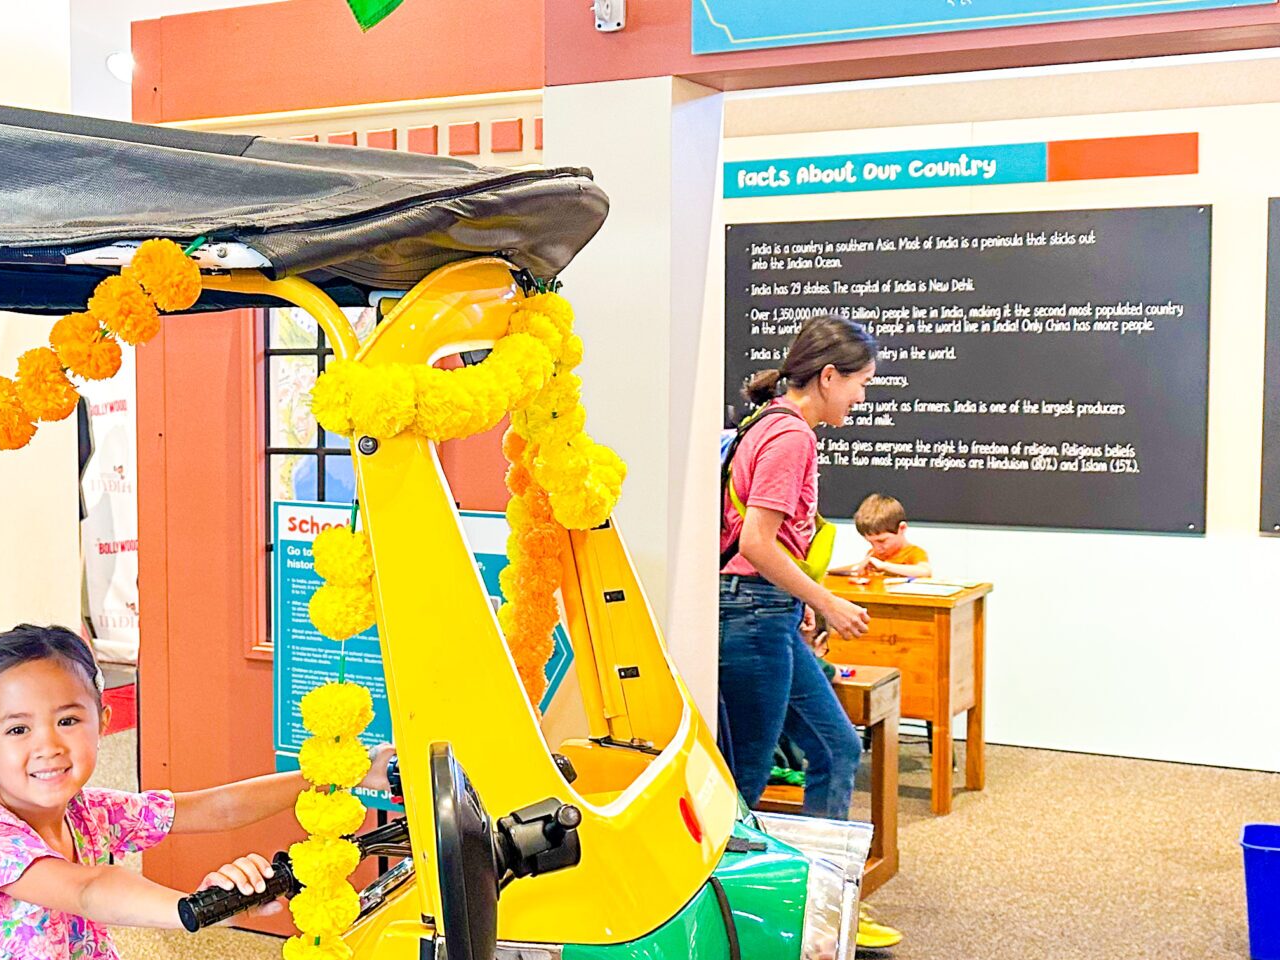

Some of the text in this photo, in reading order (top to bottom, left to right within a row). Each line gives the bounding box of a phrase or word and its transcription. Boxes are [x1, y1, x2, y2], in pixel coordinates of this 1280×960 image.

[796, 161, 857, 185] About
[863, 162, 901, 181] Our
[908, 153, 997, 179] Country
[752, 243, 772, 256] India
[774, 243, 781, 254] is
[784, 245, 790, 254] a
[792, 240, 823, 254] country
[825, 242, 833, 253] in
[836, 239, 874, 252] southern
[899, 237, 920, 250] Most
[923, 236, 933, 249] of
[936, 236, 958, 250] India
[961, 237, 969, 248] is
[972, 238, 978, 248] a
[981, 233, 1023, 251] peninsula
[1026, 232, 1046, 246] that
[1050, 231, 1076, 245] sticks
[1078, 230, 1096, 244] out
[752, 259, 768, 270] into
[770, 258, 784, 269] the
[787, 257, 812, 269] Indian
[751, 284, 771, 296] India
[774, 283, 788, 295] has
[791, 282, 801, 295] 29
[804, 282, 830, 294] states.
[834, 281, 848, 293] The
[851, 280, 879, 294] capital
[882, 280, 891, 292] of
[894, 280, 916, 293] India
[919, 281, 926, 292] is
[929, 279, 949, 292] New
[751, 301, 1184, 322] Over 1,350,000000 (135 billion) people live in India, making it the second most populated country
[752, 324, 759, 334] in
[762, 322, 775, 334] the
[868, 322, 874, 334] 6
[876, 321, 903, 336] people
[906, 321, 915, 333] in
[918, 321, 932, 333] the
[936, 321, 961, 333] world
[964, 321, 978, 332] live
[982, 321, 990, 332] in
[1022, 320, 1042, 334] Only
[1046, 320, 1070, 332] China
[1074, 319, 1090, 331] has
[1094, 321, 1118, 331] more
[751, 348, 771, 360] India
[774, 349, 780, 360] is
[900, 348, 908, 359] in
[911, 347, 925, 359] the
[866, 376, 909, 388] emocracy.
[851, 401, 874, 413] untry
[876, 400, 898, 412] work
[901, 402, 912, 412] as
[954, 400, 976, 413] India
[979, 401, 988, 413] is
[990, 404, 1006, 413] one
[1009, 400, 1020, 413] of
[1023, 400, 1039, 414] the
[1042, 400, 1074, 416] largest
[1077, 401, 1126, 416] producers
[857, 414, 872, 426] and
[828, 439, 850, 451] India
[852, 440, 873, 453] gives
[876, 443, 912, 456] everyone
[916, 440, 931, 452] the
[934, 440, 955, 457] right
[958, 440, 968, 453] to
[972, 441, 1008, 454] freedom
[1011, 442, 1021, 454] of
[1062, 443, 1102, 459] Religious
[1105, 444, 1135, 457] beliefs
[817, 453, 832, 465] dia.
[834, 454, 849, 465] The
[852, 451, 869, 466] two
[871, 455, 892, 466] most
[895, 455, 928, 469] popular
[930, 455, 966, 470] religions
[968, 459, 984, 469] are
[987, 456, 1028, 470] Hinduism
[1060, 458, 1078, 471] and
[1081, 459, 1107, 472] Islam
[288, 515, 350, 534] Sch
[287, 546, 300, 556] Go
[287, 559, 315, 569] histor
